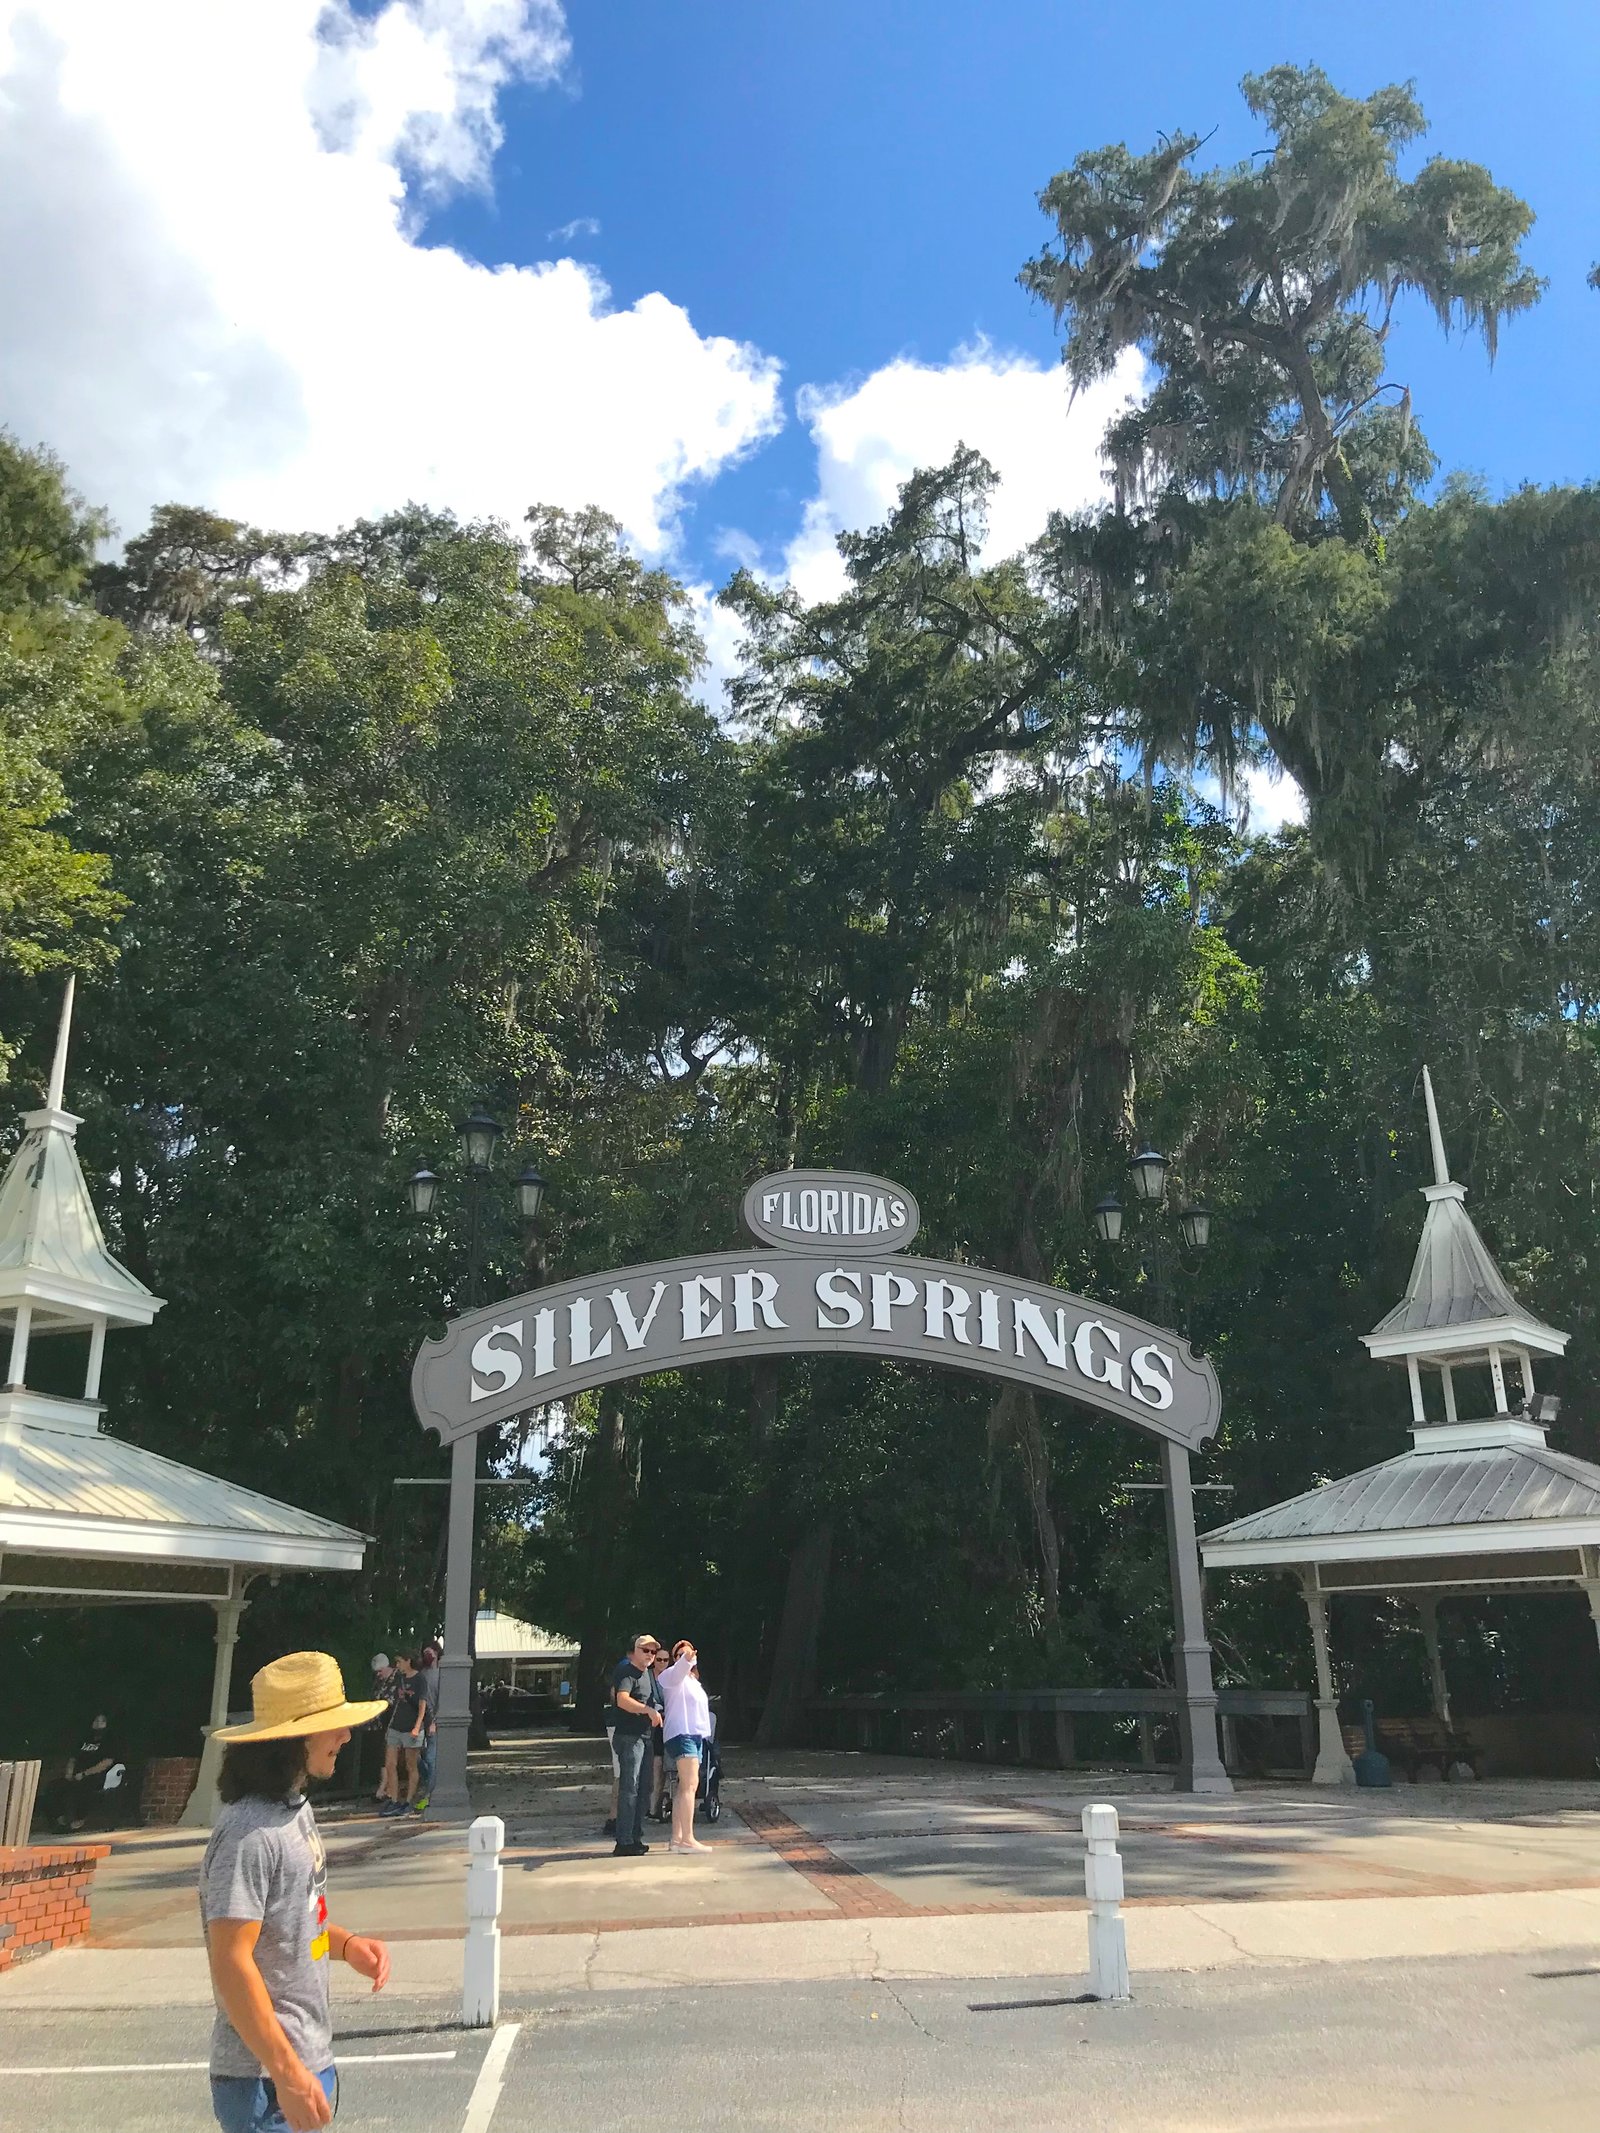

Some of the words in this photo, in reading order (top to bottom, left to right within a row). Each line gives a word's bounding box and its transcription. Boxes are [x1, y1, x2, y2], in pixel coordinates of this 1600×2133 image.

[762, 1189, 906, 1236] FLORIDA'S
[470, 1268, 790, 1403] SILVER
[814, 1267, 1174, 1410] SPRINGS
